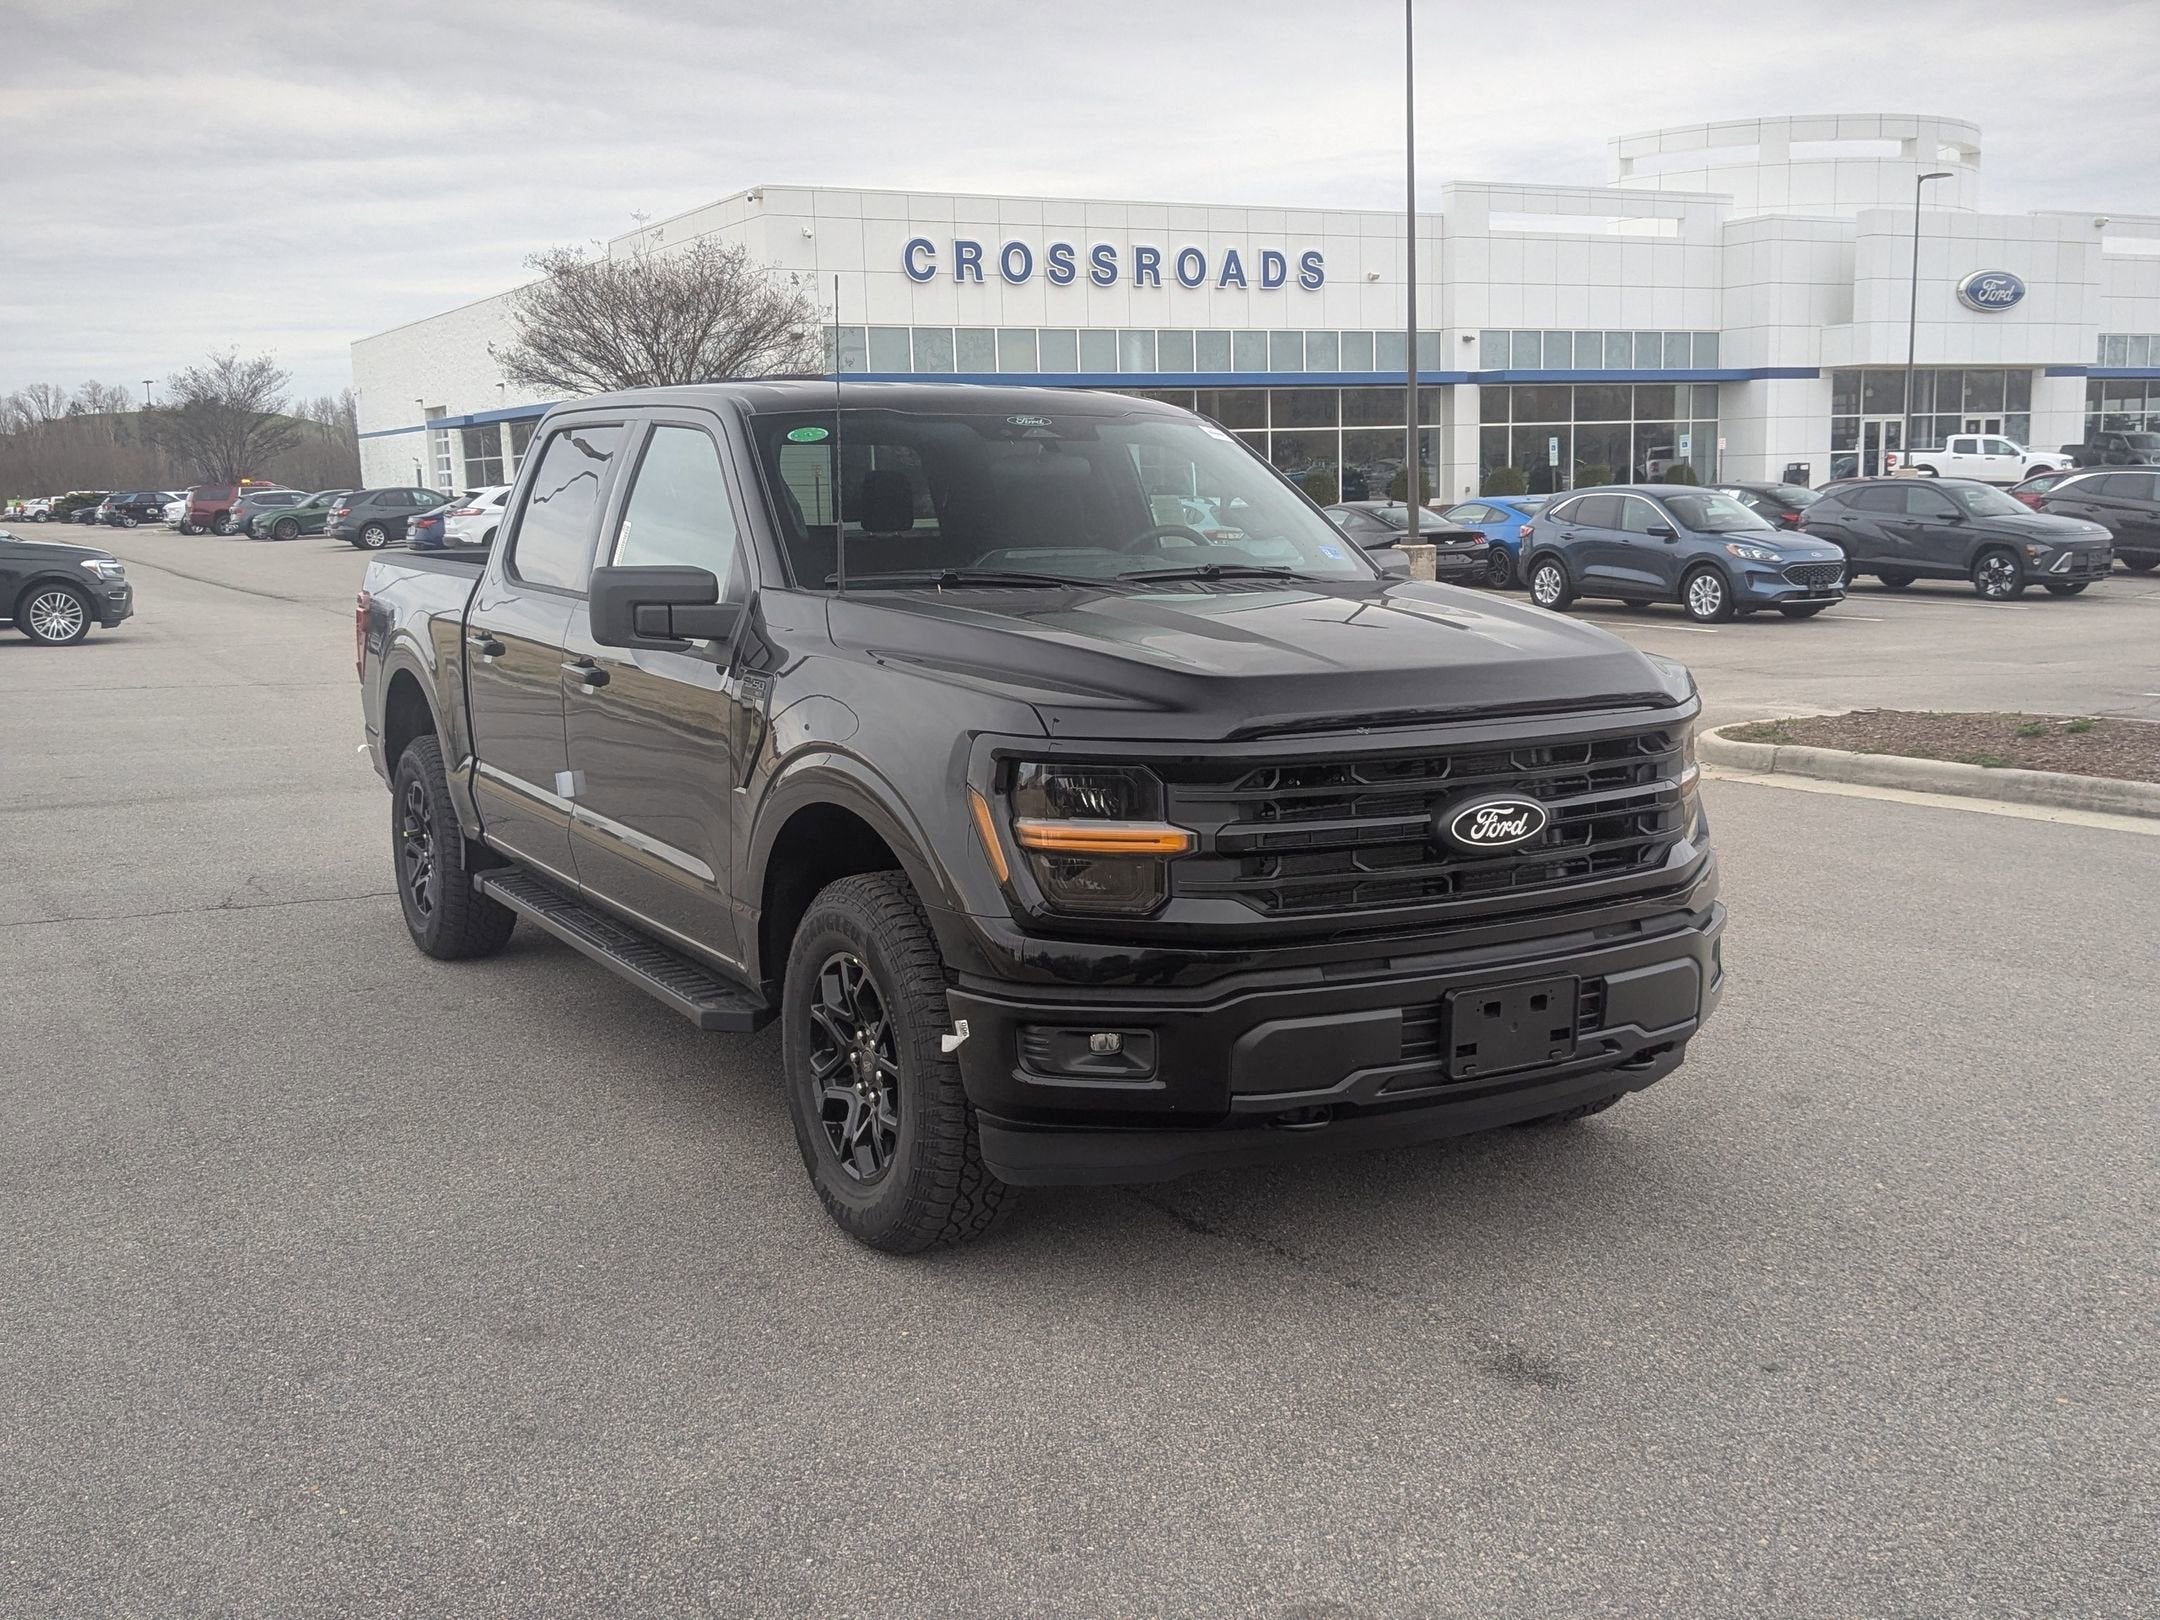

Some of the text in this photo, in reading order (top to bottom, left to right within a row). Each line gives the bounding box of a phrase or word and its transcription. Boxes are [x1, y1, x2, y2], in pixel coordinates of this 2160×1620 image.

[903, 237, 1325, 291] CROSSROADS
[1978, 279, 2016, 302] Ford
[1470, 807, 1529, 840] Ford
